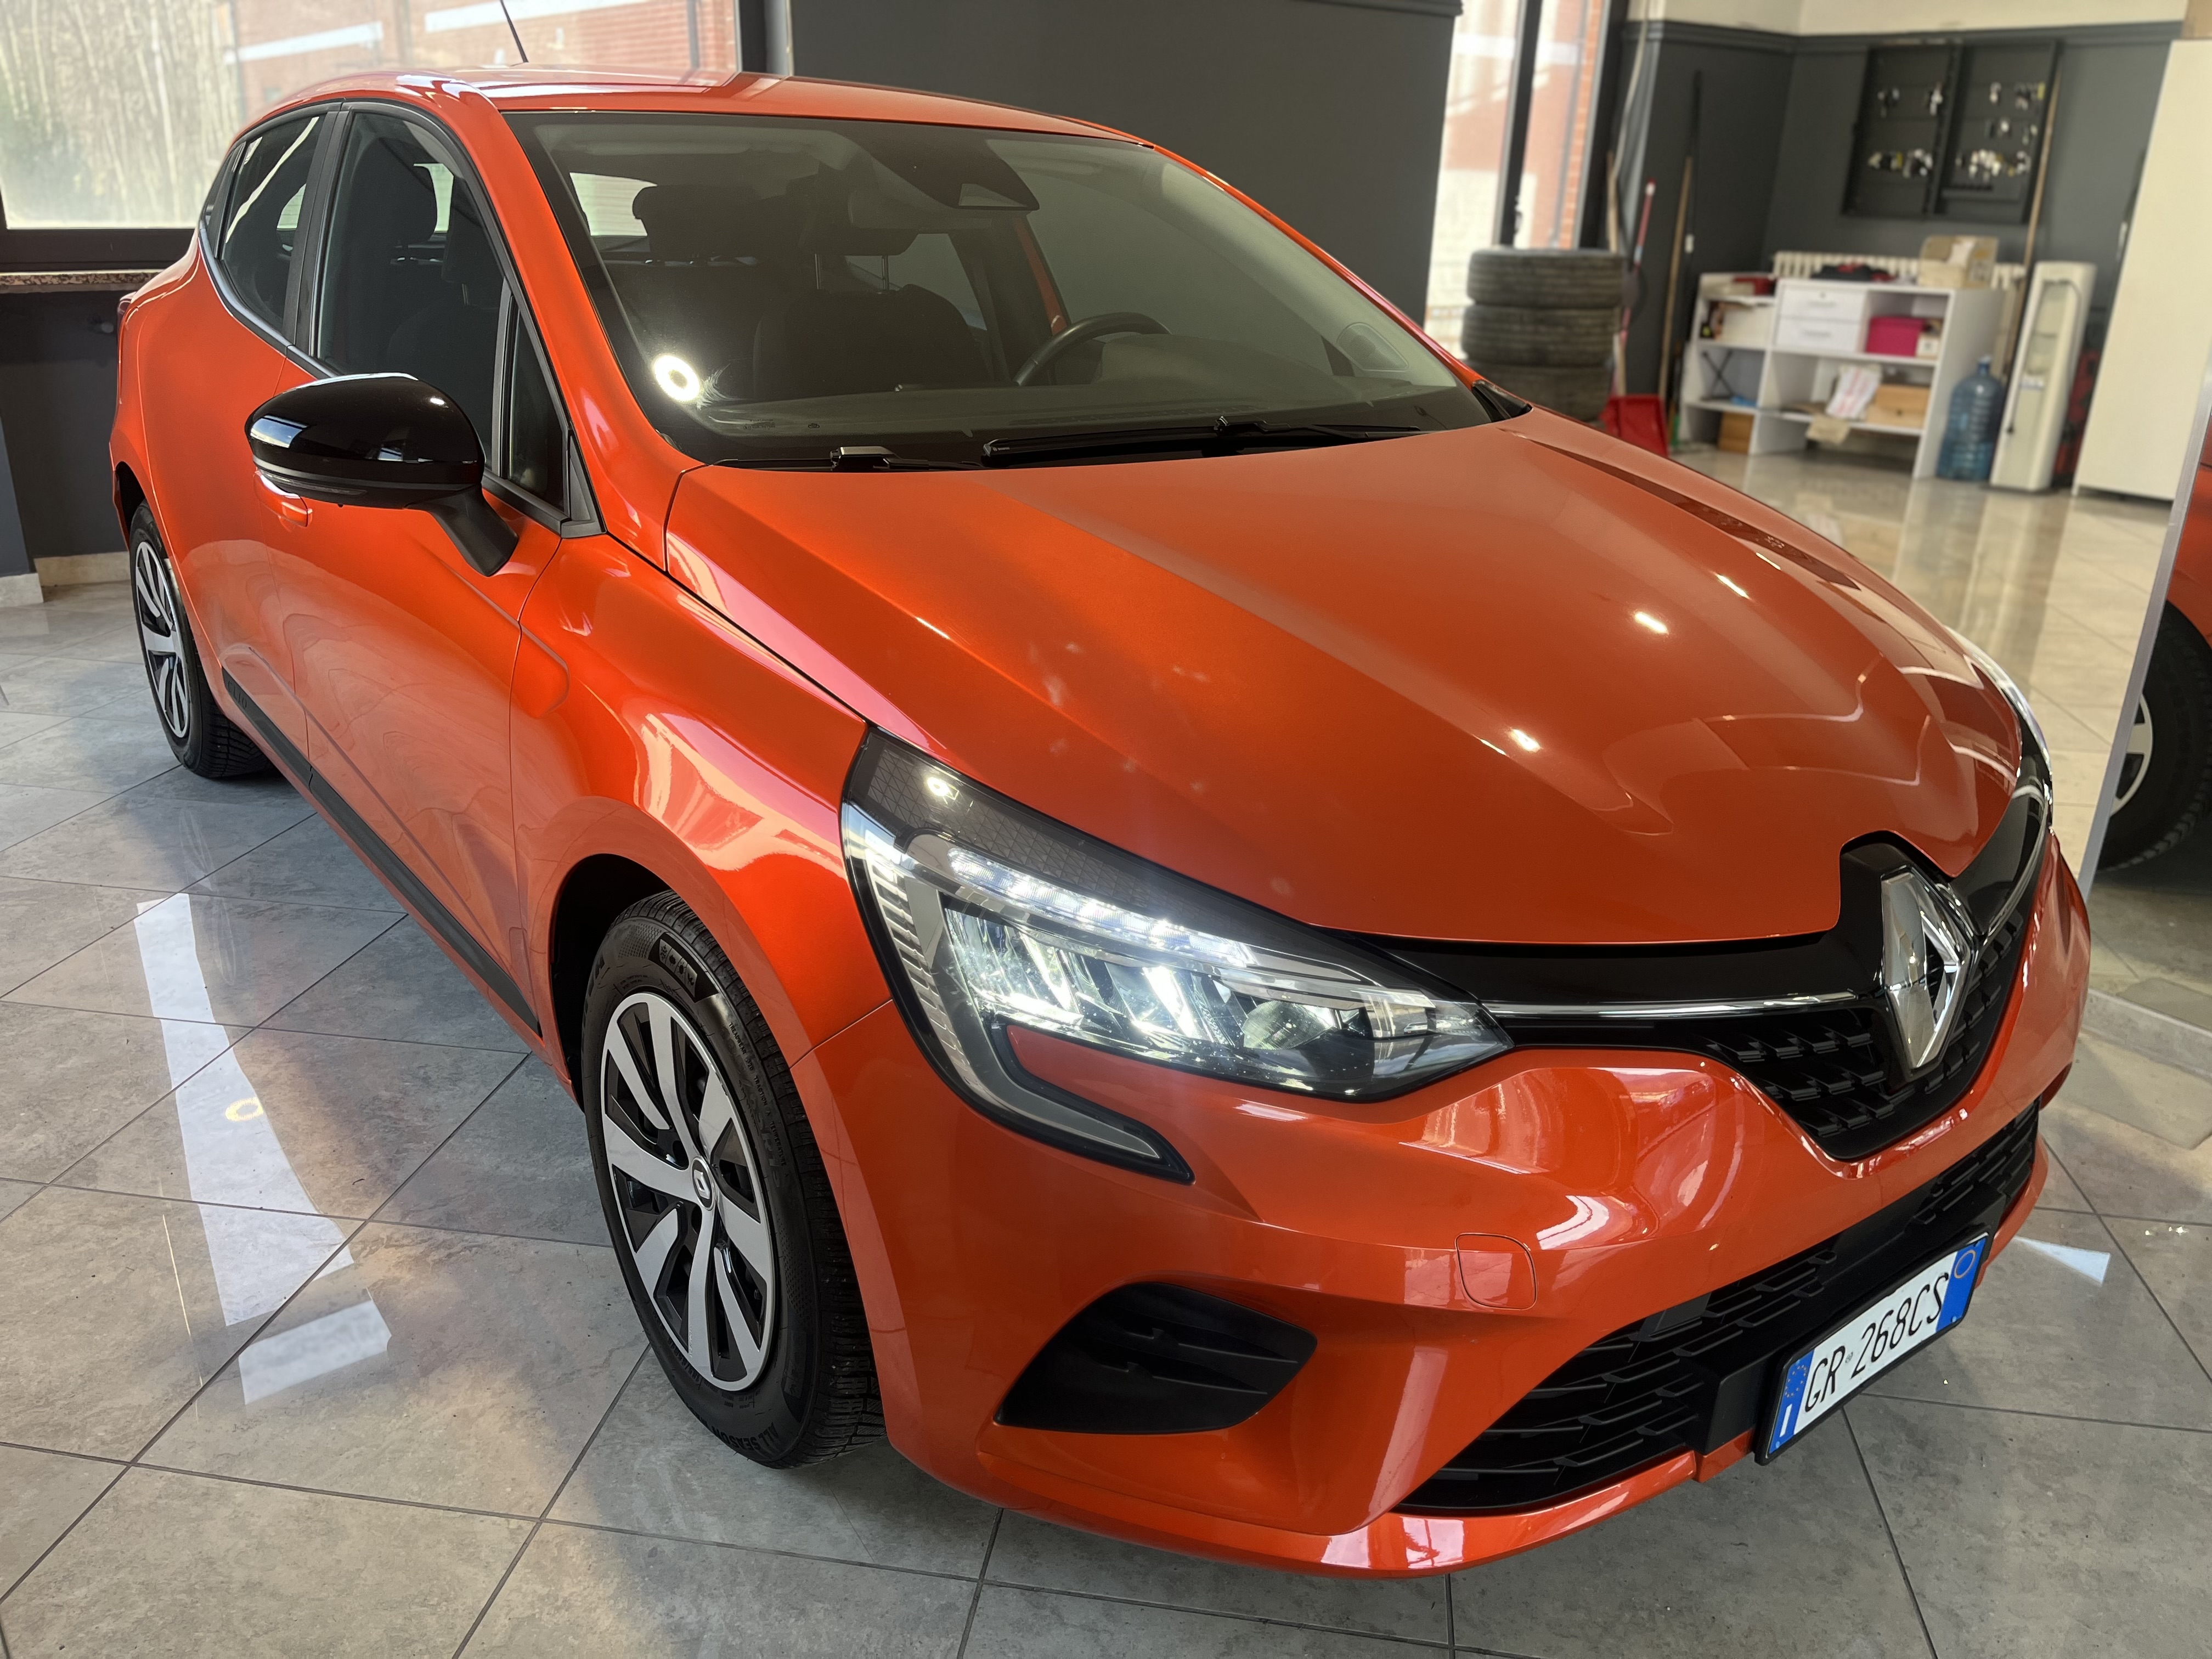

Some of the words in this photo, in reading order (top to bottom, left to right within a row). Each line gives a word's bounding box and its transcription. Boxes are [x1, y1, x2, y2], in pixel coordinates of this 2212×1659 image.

[228, 680, 247, 710] CLIO
[729, 1022, 747, 1055] TREADWEAR
[753, 1075, 768, 1106] TRACTION
[770, 1120, 787, 1166] TEMPERATURE
[1804, 1345, 1846, 1413] GR
[1850, 1272, 1949, 1379] 268CS
[711, 1425, 761, 1451] SEASON
[758, 1422, 780, 1448] ALL
